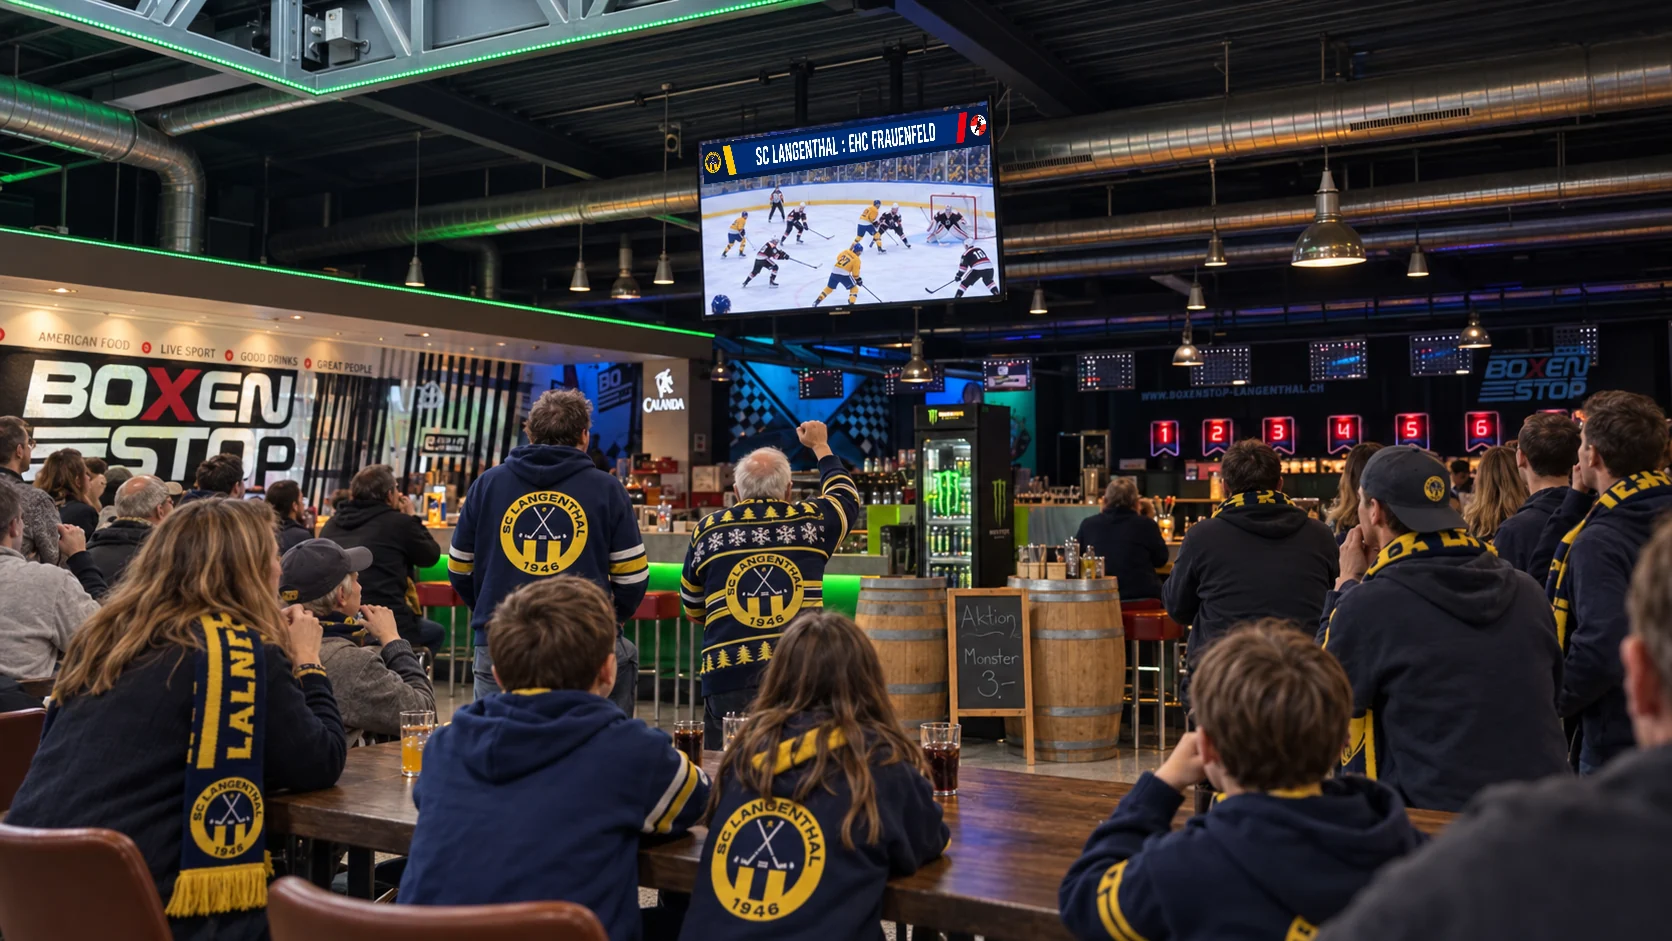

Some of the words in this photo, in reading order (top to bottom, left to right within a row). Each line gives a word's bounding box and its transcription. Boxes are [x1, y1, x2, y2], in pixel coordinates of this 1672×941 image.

[755, 145, 770, 166] SC
[772, 136, 839, 164] LANGENTHAL
[848, 131, 869, 153] EHC
[871, 122, 936, 150] FRAUENFELD
[837, 254, 851, 267] 27
[38, 331, 98, 347] AMERICAN
[100, 336, 131, 351] FOOD
[160, 343, 182, 356] LIVE
[185, 345, 216, 359] SPORT
[240, 351, 266, 363] GOOD
[267, 354, 299, 366] DRINKS
[317, 359, 343, 371] GREAT
[344, 362, 373, 375] PEOPLE
[1484, 356, 1591, 379] BOXEN
[23, 359, 293, 425] BOXEN
[1141, 383, 1325, 401] WWW.BOXENSTOP-LANGENTHAL.CH
[1514, 381, 1587, 401] STOP
[1160, 427, 1168, 443] 1
[1211, 425, 1223, 442] 2
[1272, 424, 1284, 440] 3
[1337, 422, 1350, 439] 4
[1406, 421, 1418, 437] 5
[1475, 419, 1487, 436] 6
[110, 425, 296, 486] STOP
[502, 516, 514, 534] SC
[512, 492, 586, 538] LANGENTHAL
[523, 561, 560, 573] 1946
[727, 579, 736, 596] SC
[734, 555, 803, 592] LANGENTHAL
[750, 614, 784, 627] 1946
[960, 604, 1018, 639] Aktion
[964, 647, 1020, 665] Monster
[193, 803, 205, 822] SC
[202, 780, 262, 818] LANGENTHAL
[716, 831, 732, 855] SC
[730, 800, 822, 868] LANGENTHAL
[214, 843, 244, 856] 1946
[732, 897, 780, 917] 1946
